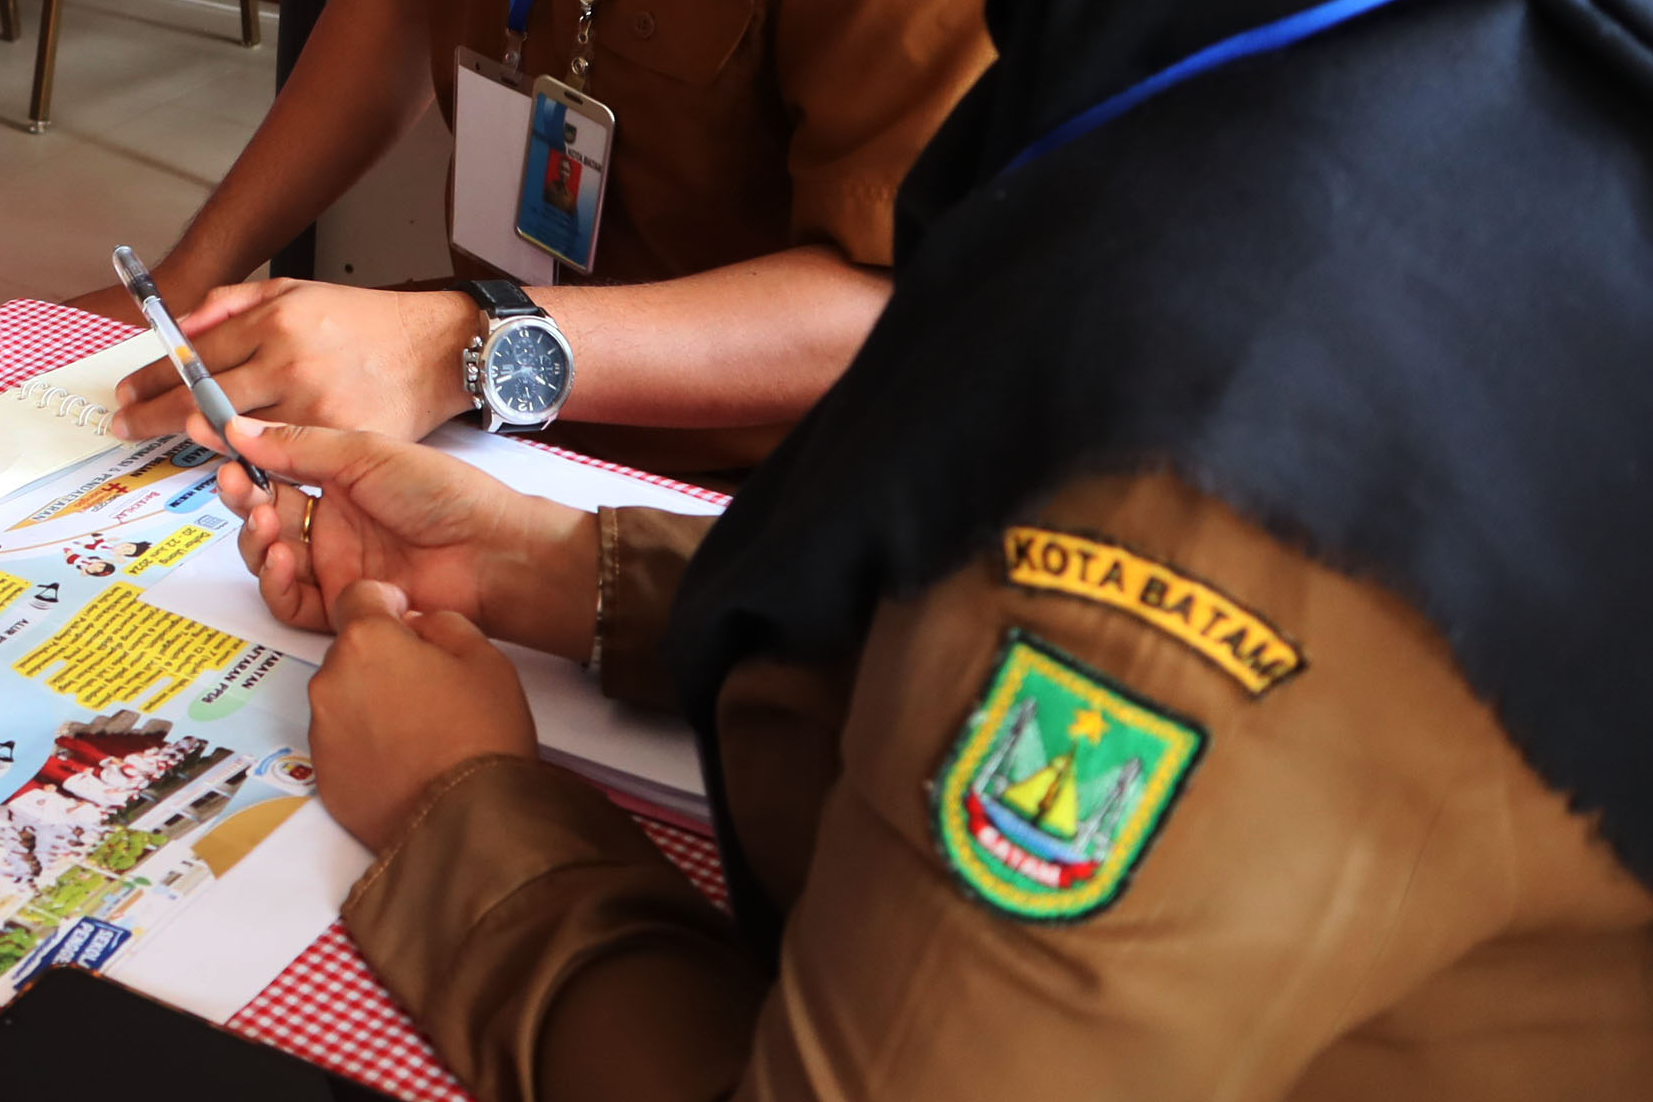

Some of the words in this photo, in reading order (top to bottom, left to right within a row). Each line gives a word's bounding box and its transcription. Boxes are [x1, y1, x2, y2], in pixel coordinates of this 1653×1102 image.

[181, 526, 196, 537] 20
[163, 538, 180, 549] 22
[149, 546, 167, 560] Juni
[157, 547, 187, 566] Ulang
[126, 556, 153, 576] 2024
[1013, 534, 1125, 593] KOTA
[1140, 576, 1288, 679] BATAM
[3, 618, 29, 636] ALUR
